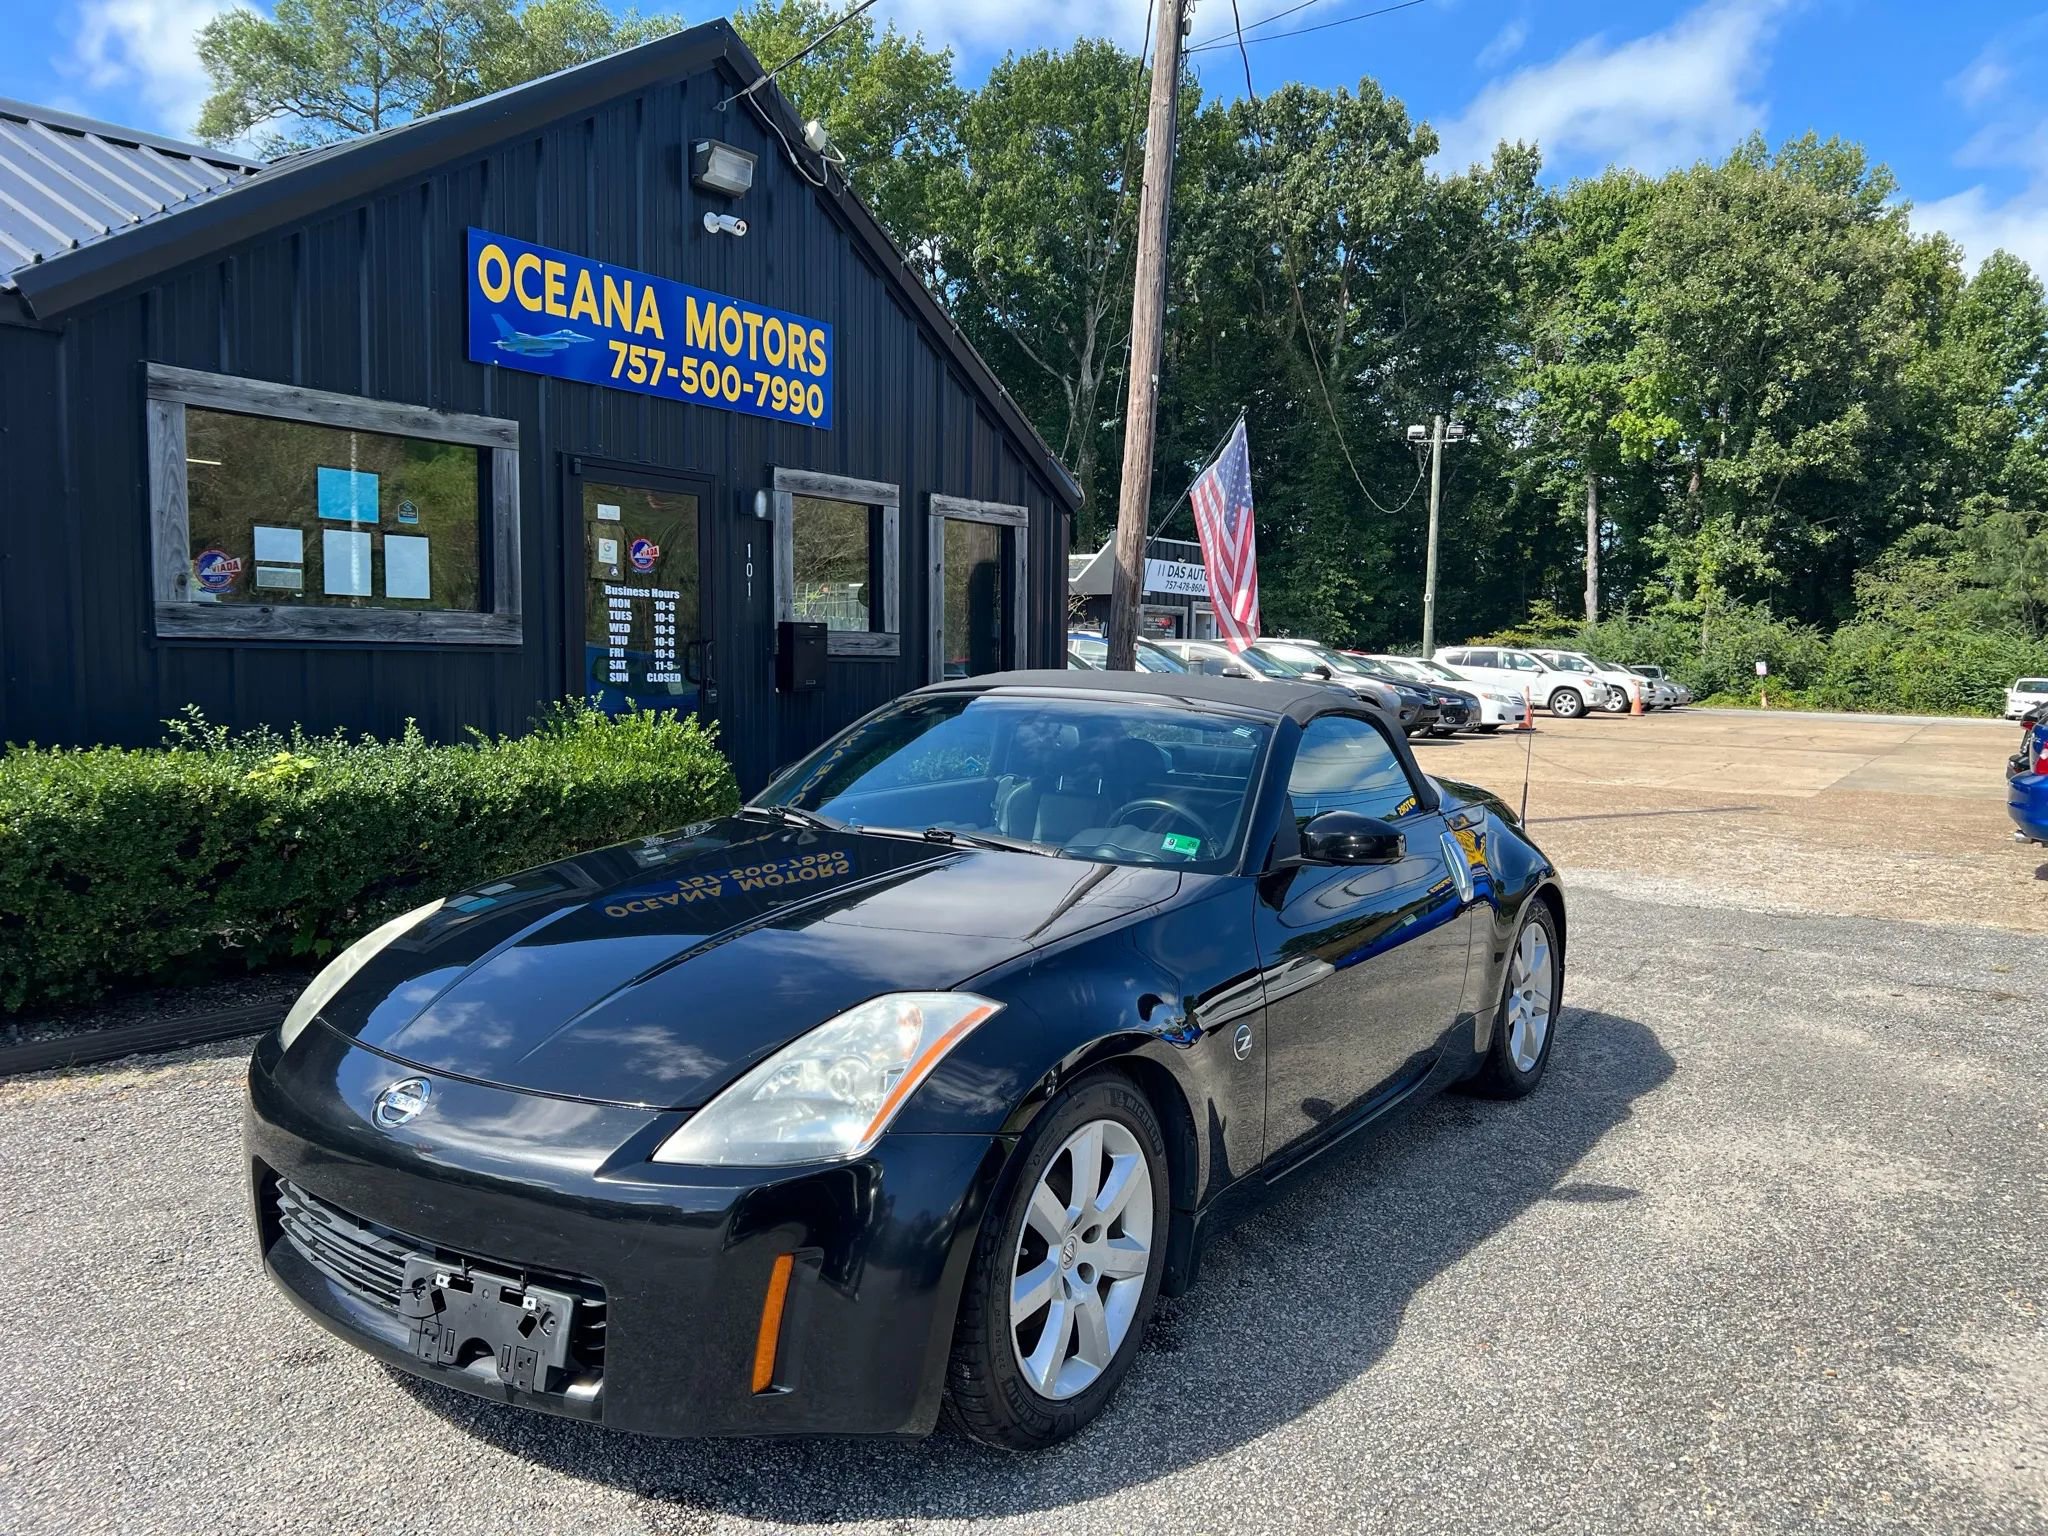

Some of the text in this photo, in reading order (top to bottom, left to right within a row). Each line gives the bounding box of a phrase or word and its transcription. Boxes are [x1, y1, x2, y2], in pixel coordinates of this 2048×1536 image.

[477, 243, 827, 377] OCEANA MOTORS
[608, 340, 824, 419] 757-500-7990
[1167, 564, 1186, 579] DAS
[604, 584, 680, 599] Business Hours
[609, 598, 676, 611] MON 10-6
[608, 610, 675, 623] TUES 10-6
[608, 622, 676, 635] WED 10-6
[608, 635, 675, 647] THU 10-6
[609, 647, 675, 659] FRI 10-6
[609, 660, 674, 671] SAT 11-5
[609, 672, 682, 683] SUN CLOSED
[1168, 838, 1176, 846] 9
[1237, 1034, 1253, 1053] Z
[1125, 1094, 1162, 1155] MICHELIN
